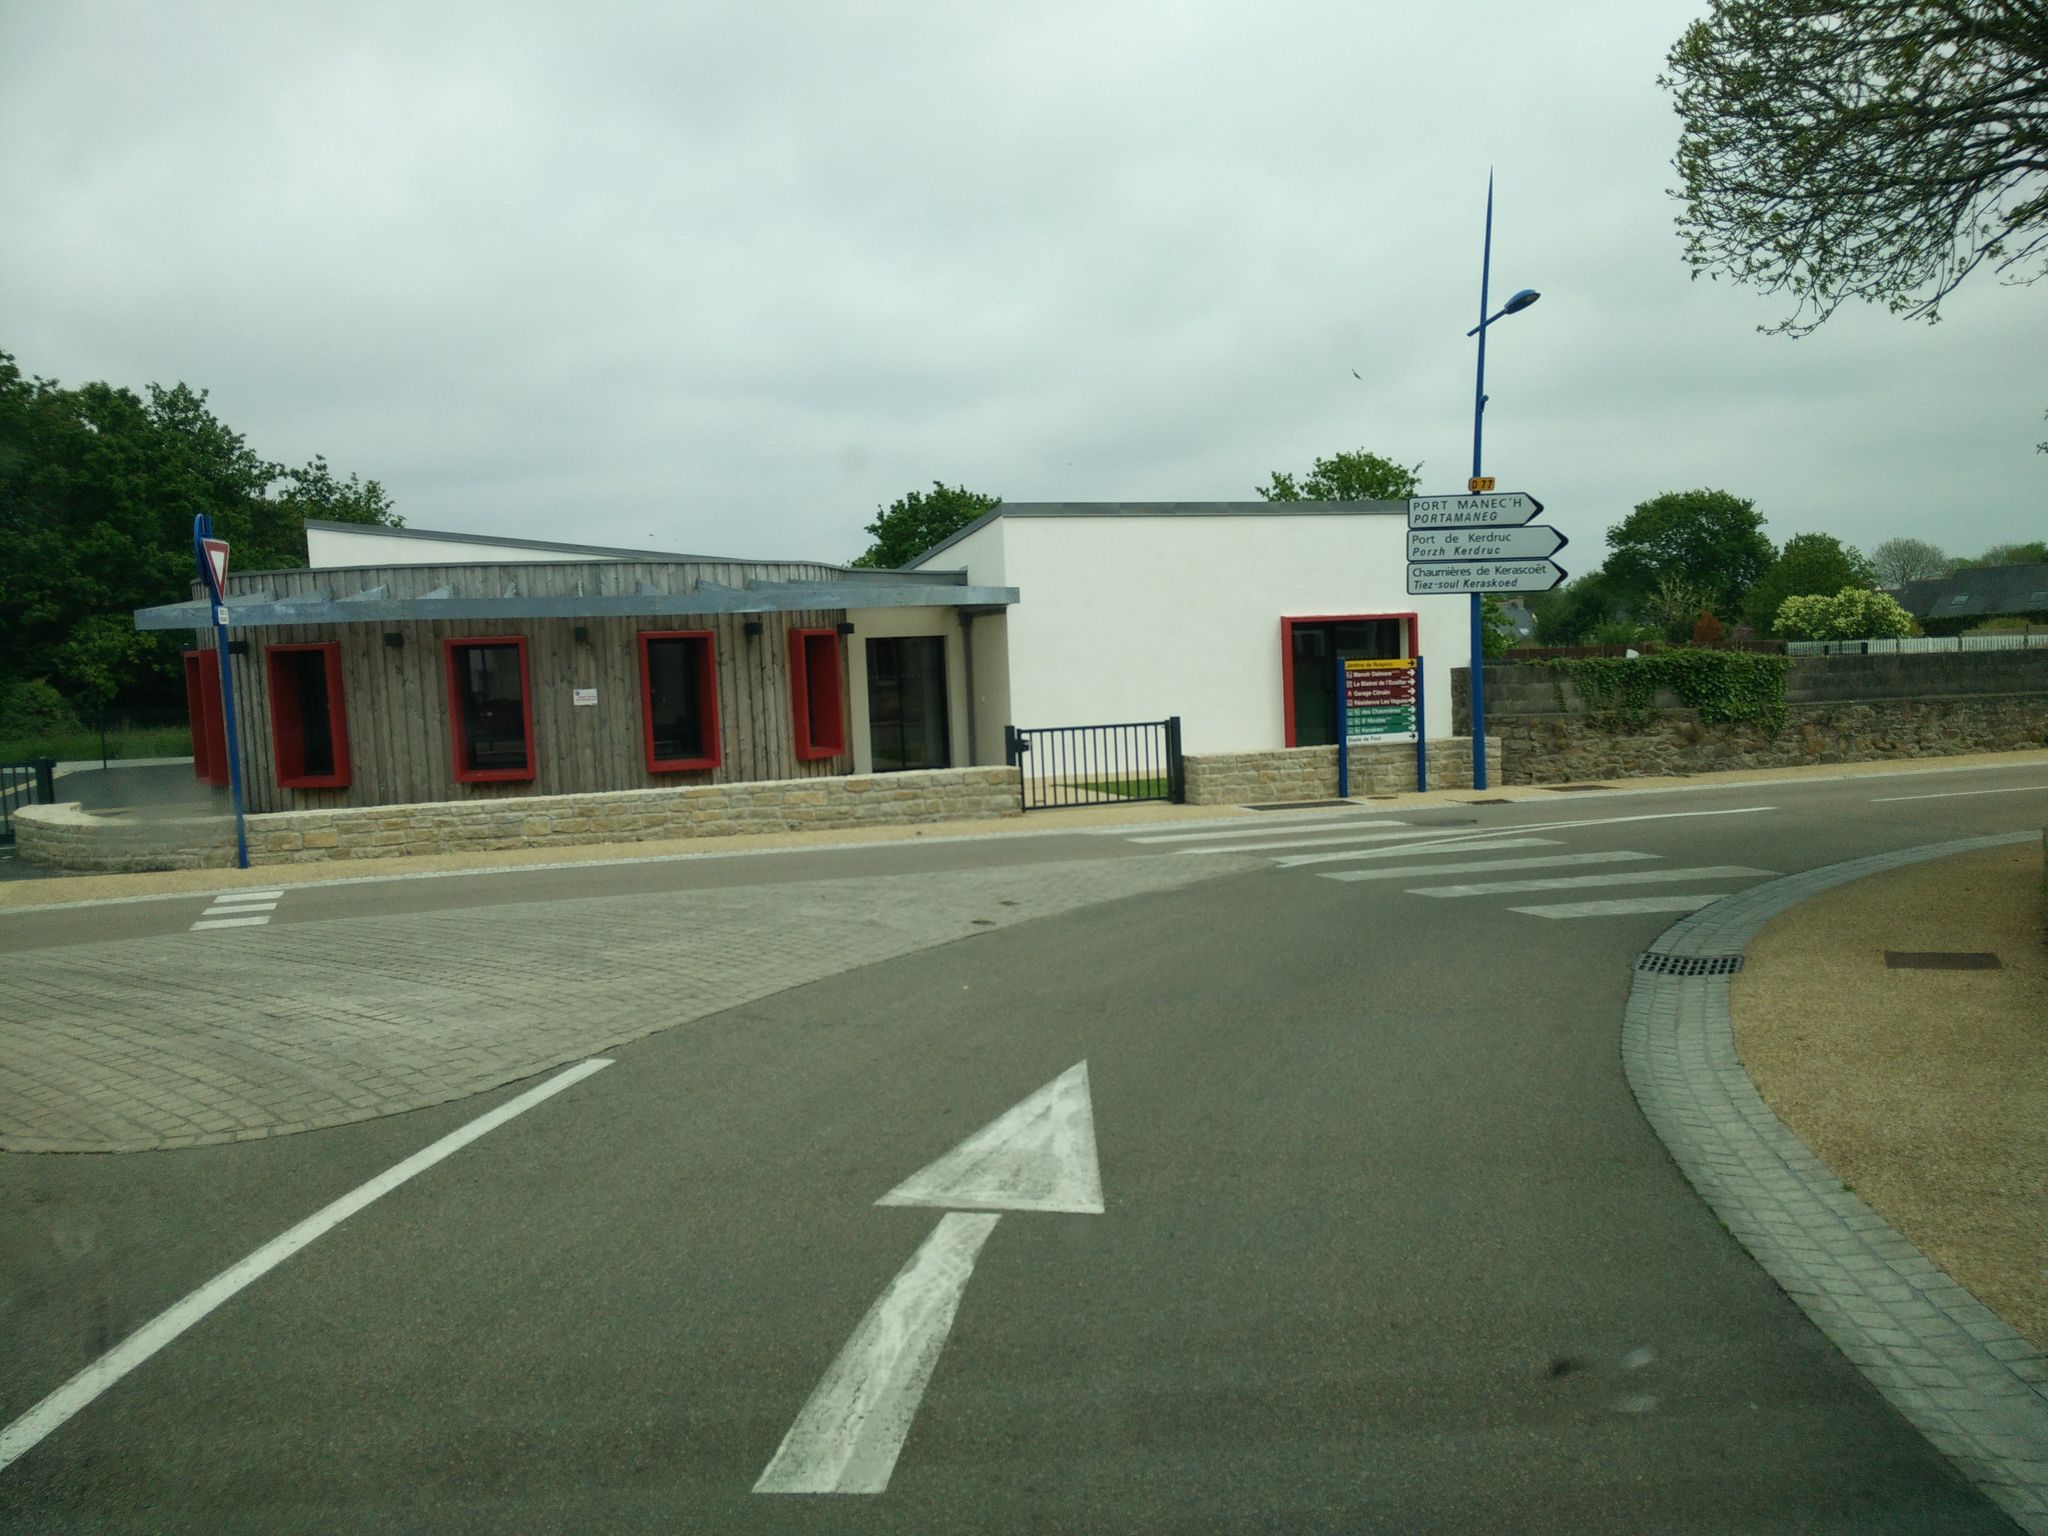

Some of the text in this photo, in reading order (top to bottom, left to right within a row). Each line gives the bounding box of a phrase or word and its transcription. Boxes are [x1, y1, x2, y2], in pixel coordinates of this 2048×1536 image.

[1472, 480, 1492, 489] D 77
[1413, 498, 1522, 511] PORT MANEC'H
[1414, 512, 1498, 523] PORTAMANEG
[1412, 533, 1511, 544] Port de Kerdruc
[1413, 546, 1501, 556] Porzh Kerdruc
[1413, 564, 1546, 577] Chaumières de Kerascoët
[1414, 578, 1518, 589] Tiez-soul Keraskoed
